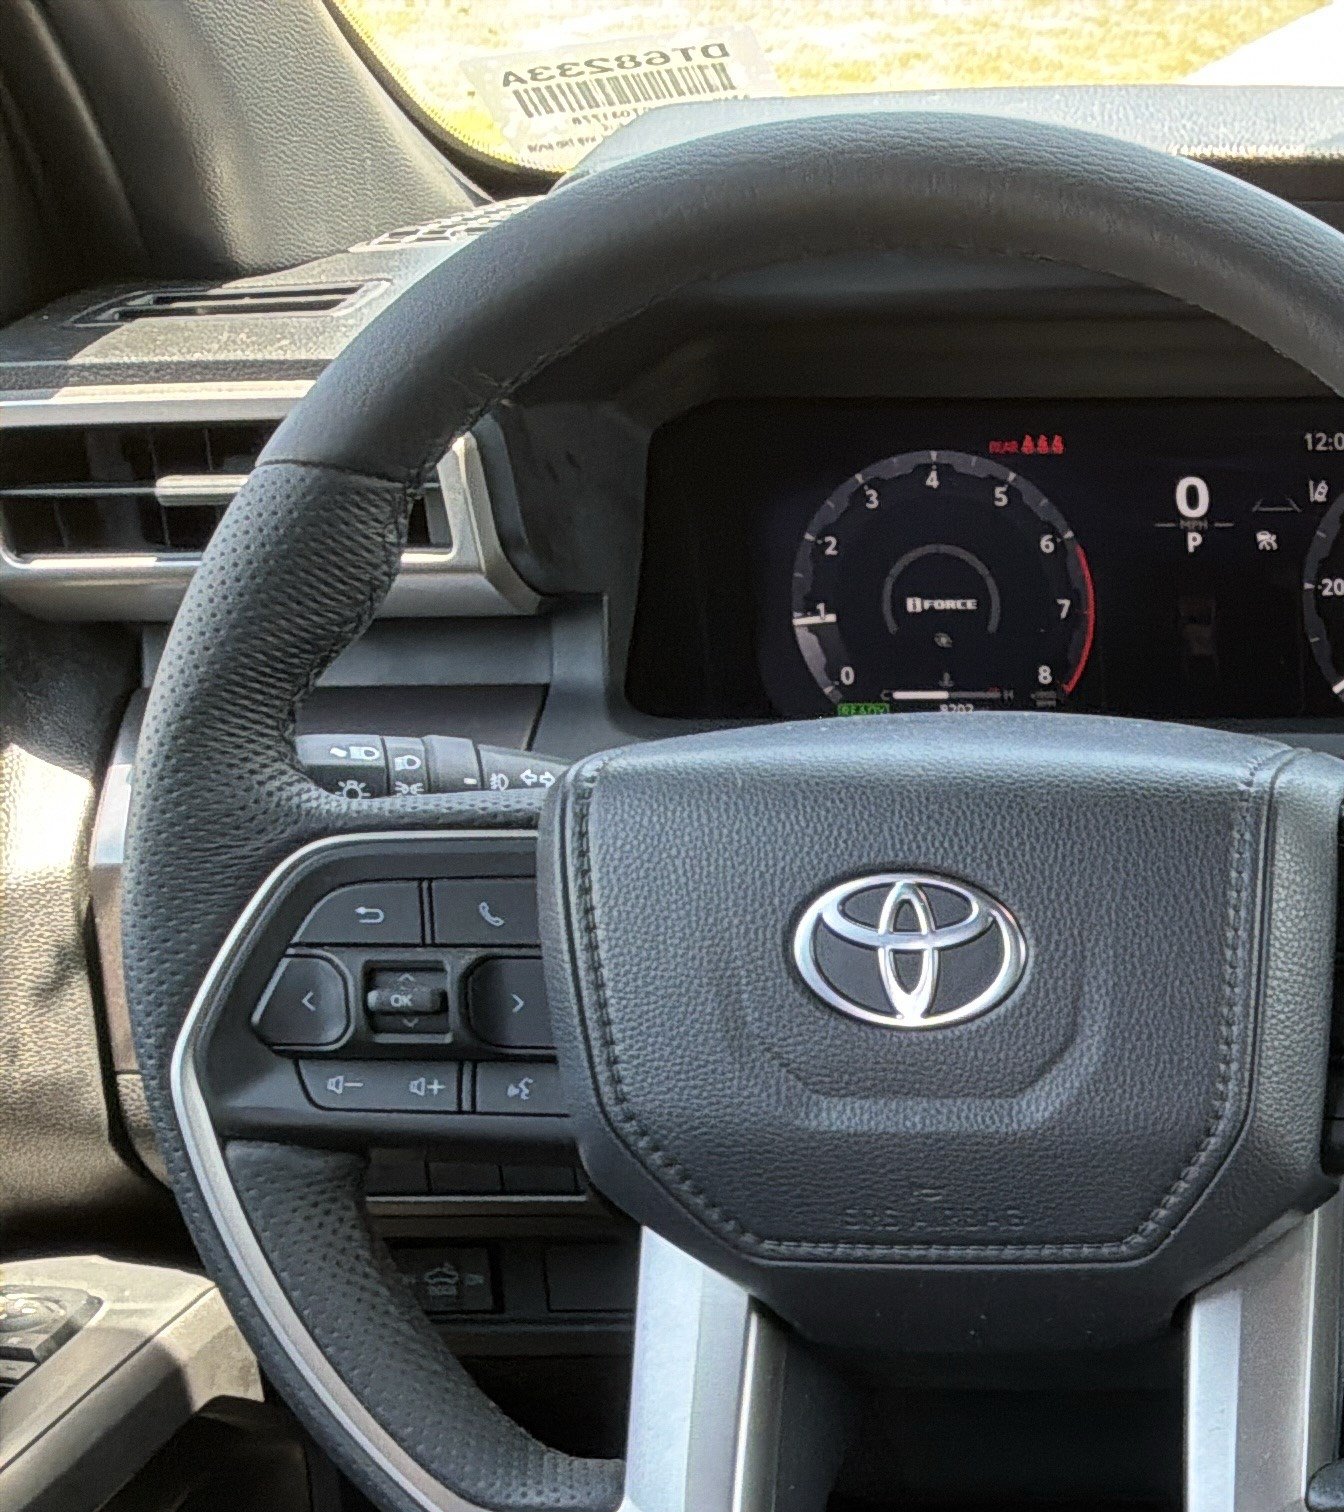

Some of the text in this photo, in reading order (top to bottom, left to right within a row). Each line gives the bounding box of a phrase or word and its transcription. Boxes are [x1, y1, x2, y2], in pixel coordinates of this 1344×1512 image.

[925, 469, 940, 489] 4
[864, 489, 880, 509] 3
[993, 486, 1009, 507] 5
[1175, 475, 1210, 518] 0
[823, 536, 838, 556] 2
[1039, 534, 1055, 554] 6
[1187, 531, 1203, 553] P
[1057, 599, 1071, 620] 7
[839, 666, 855, 686] 0
[1037, 665, 1053, 685] 8
[390, 993, 412, 1008] OK
